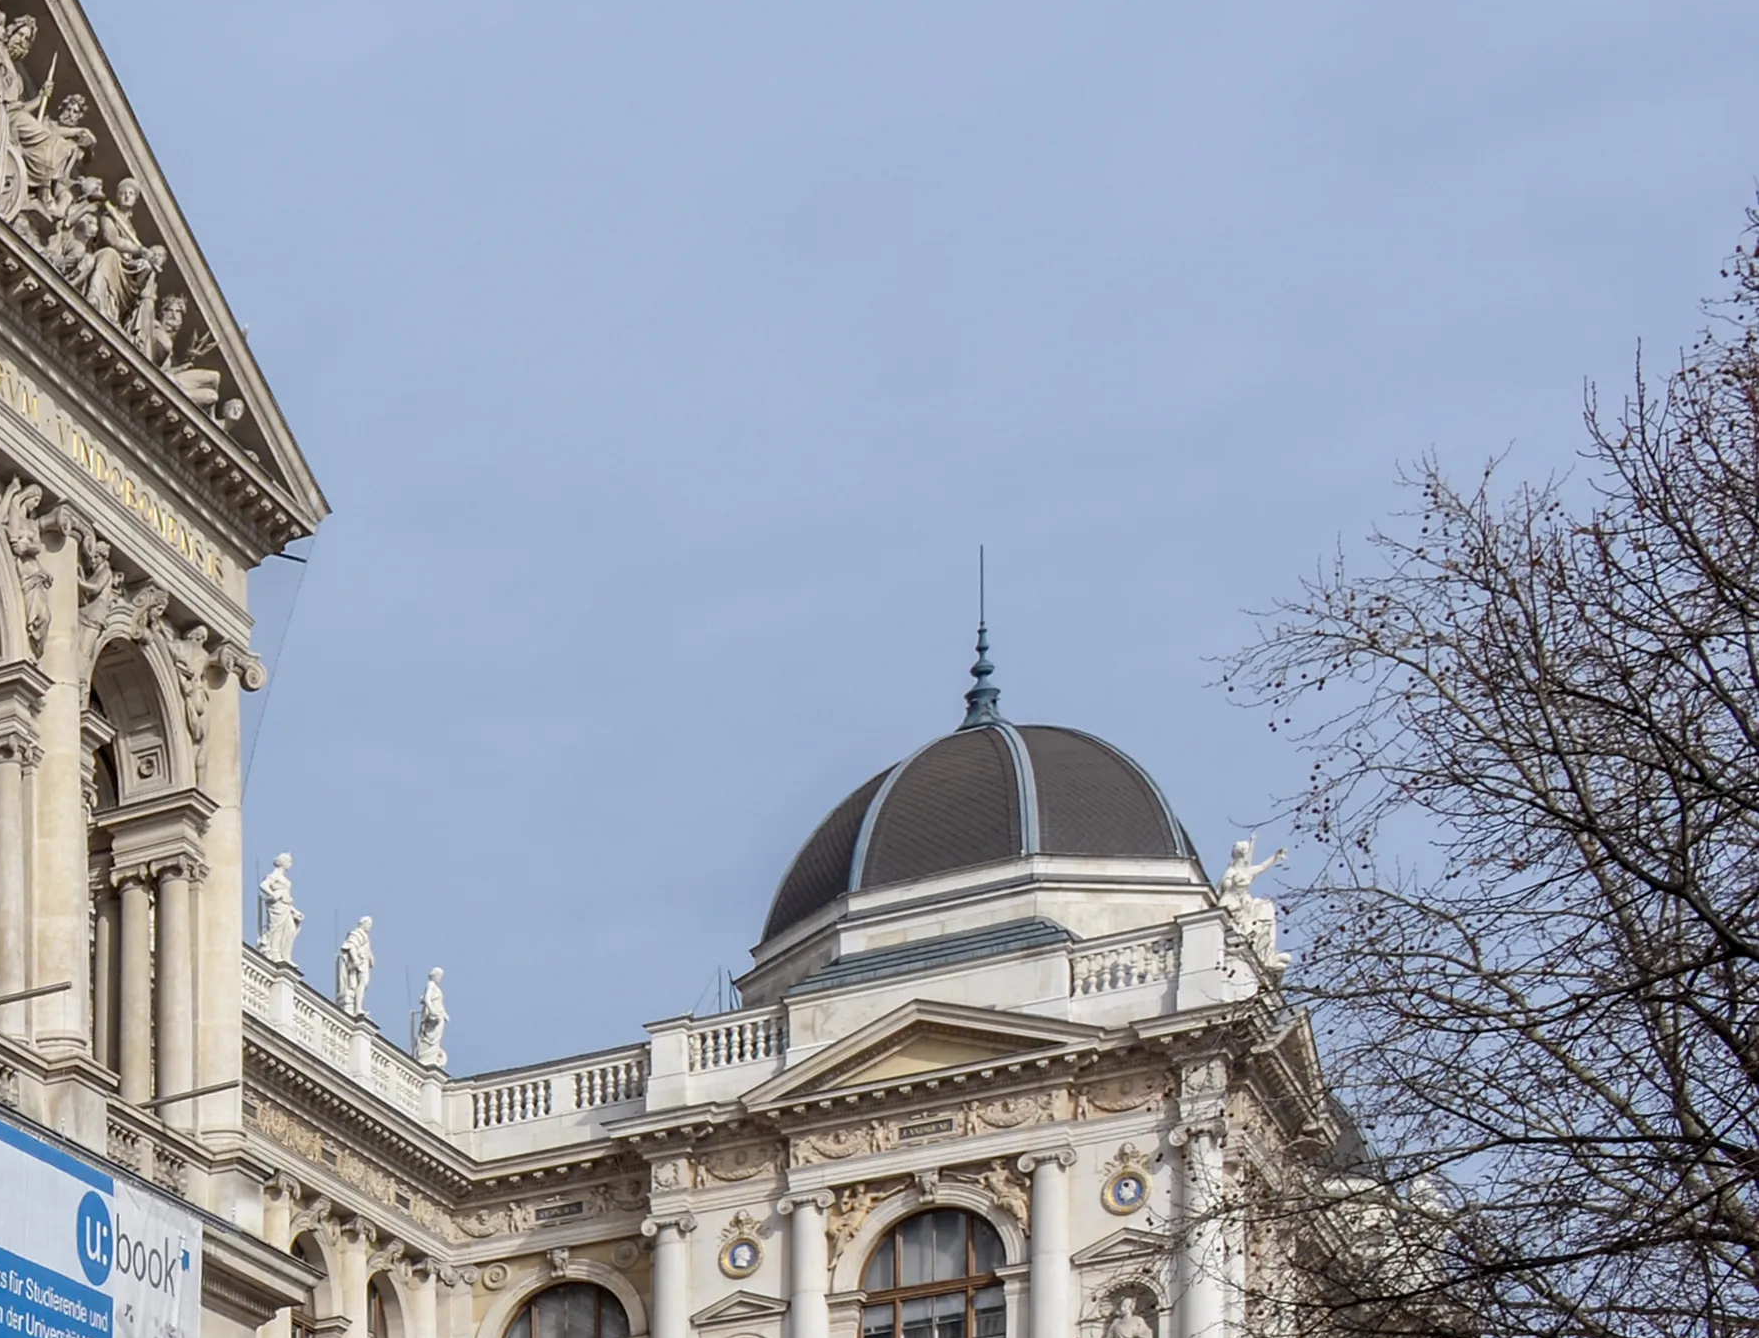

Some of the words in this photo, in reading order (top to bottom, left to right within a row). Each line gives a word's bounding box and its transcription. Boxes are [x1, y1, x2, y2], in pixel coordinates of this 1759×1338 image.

[55, 414, 224, 589] VINDOBONENSIS
[6, 1305, 24, 1332] der
[9, 1269, 24, 1297] für
[25, 1277, 87, 1323] Studierende
[89, 1308, 108, 1333] und
